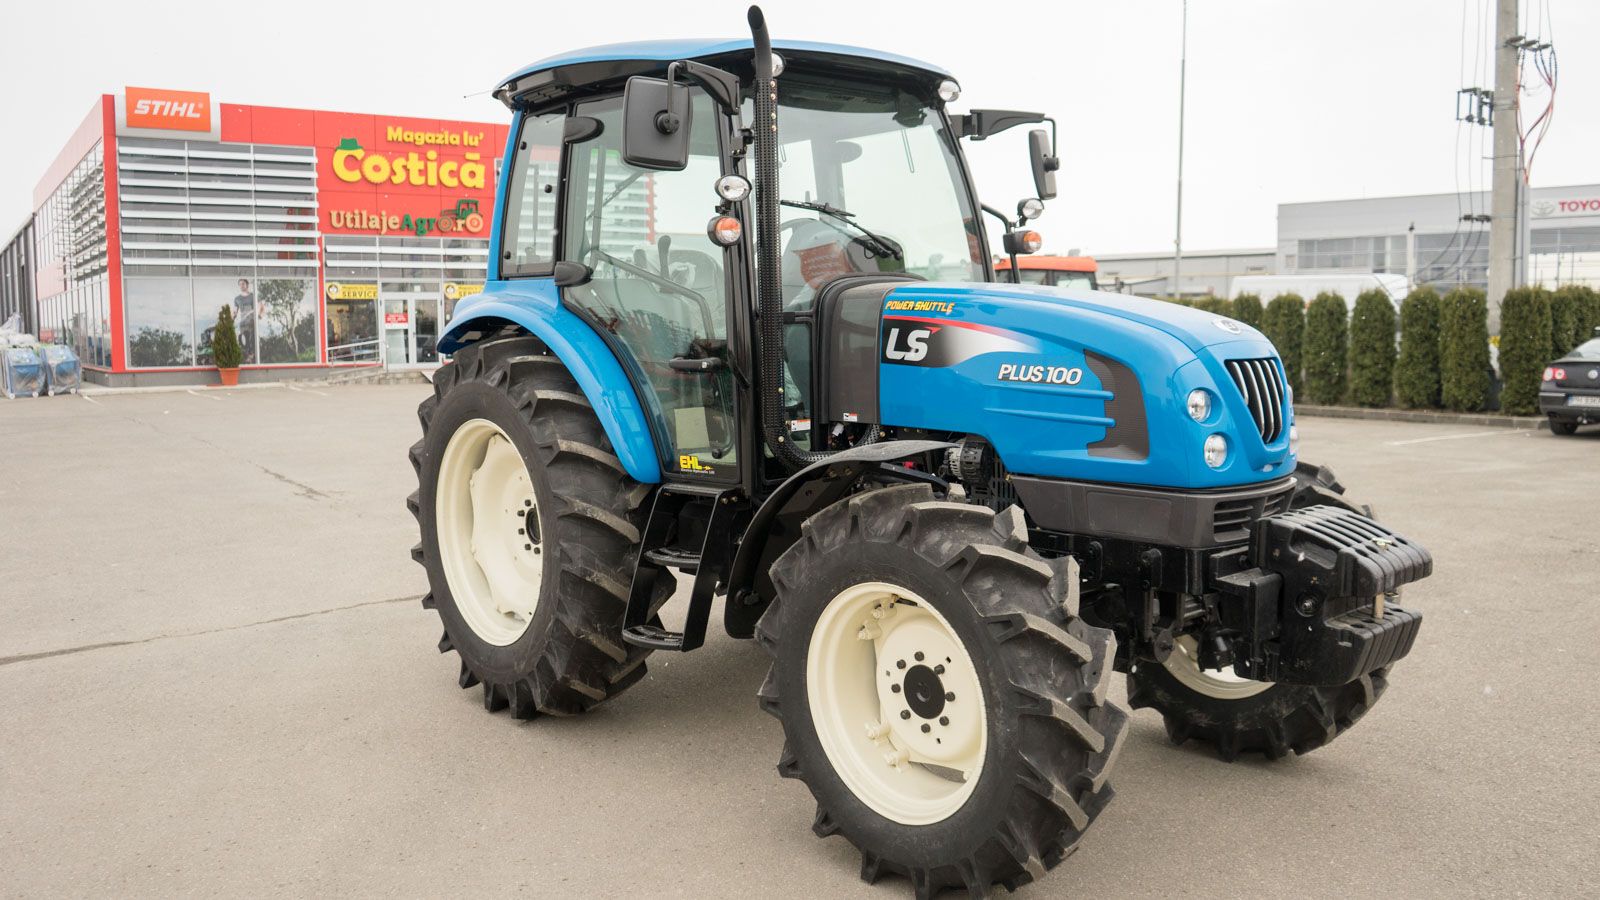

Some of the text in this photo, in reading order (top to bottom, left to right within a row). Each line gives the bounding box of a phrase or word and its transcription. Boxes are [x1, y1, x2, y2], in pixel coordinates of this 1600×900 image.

[133, 99, 201, 118] STIHL
[386, 126, 461, 146] Magazia
[885, 300, 955, 313] POWER SHUTTLE
[885, 327, 931, 362] LS
[998, 364, 1083, 385] PLUS 100
[679, 455, 703, 470] EHL
